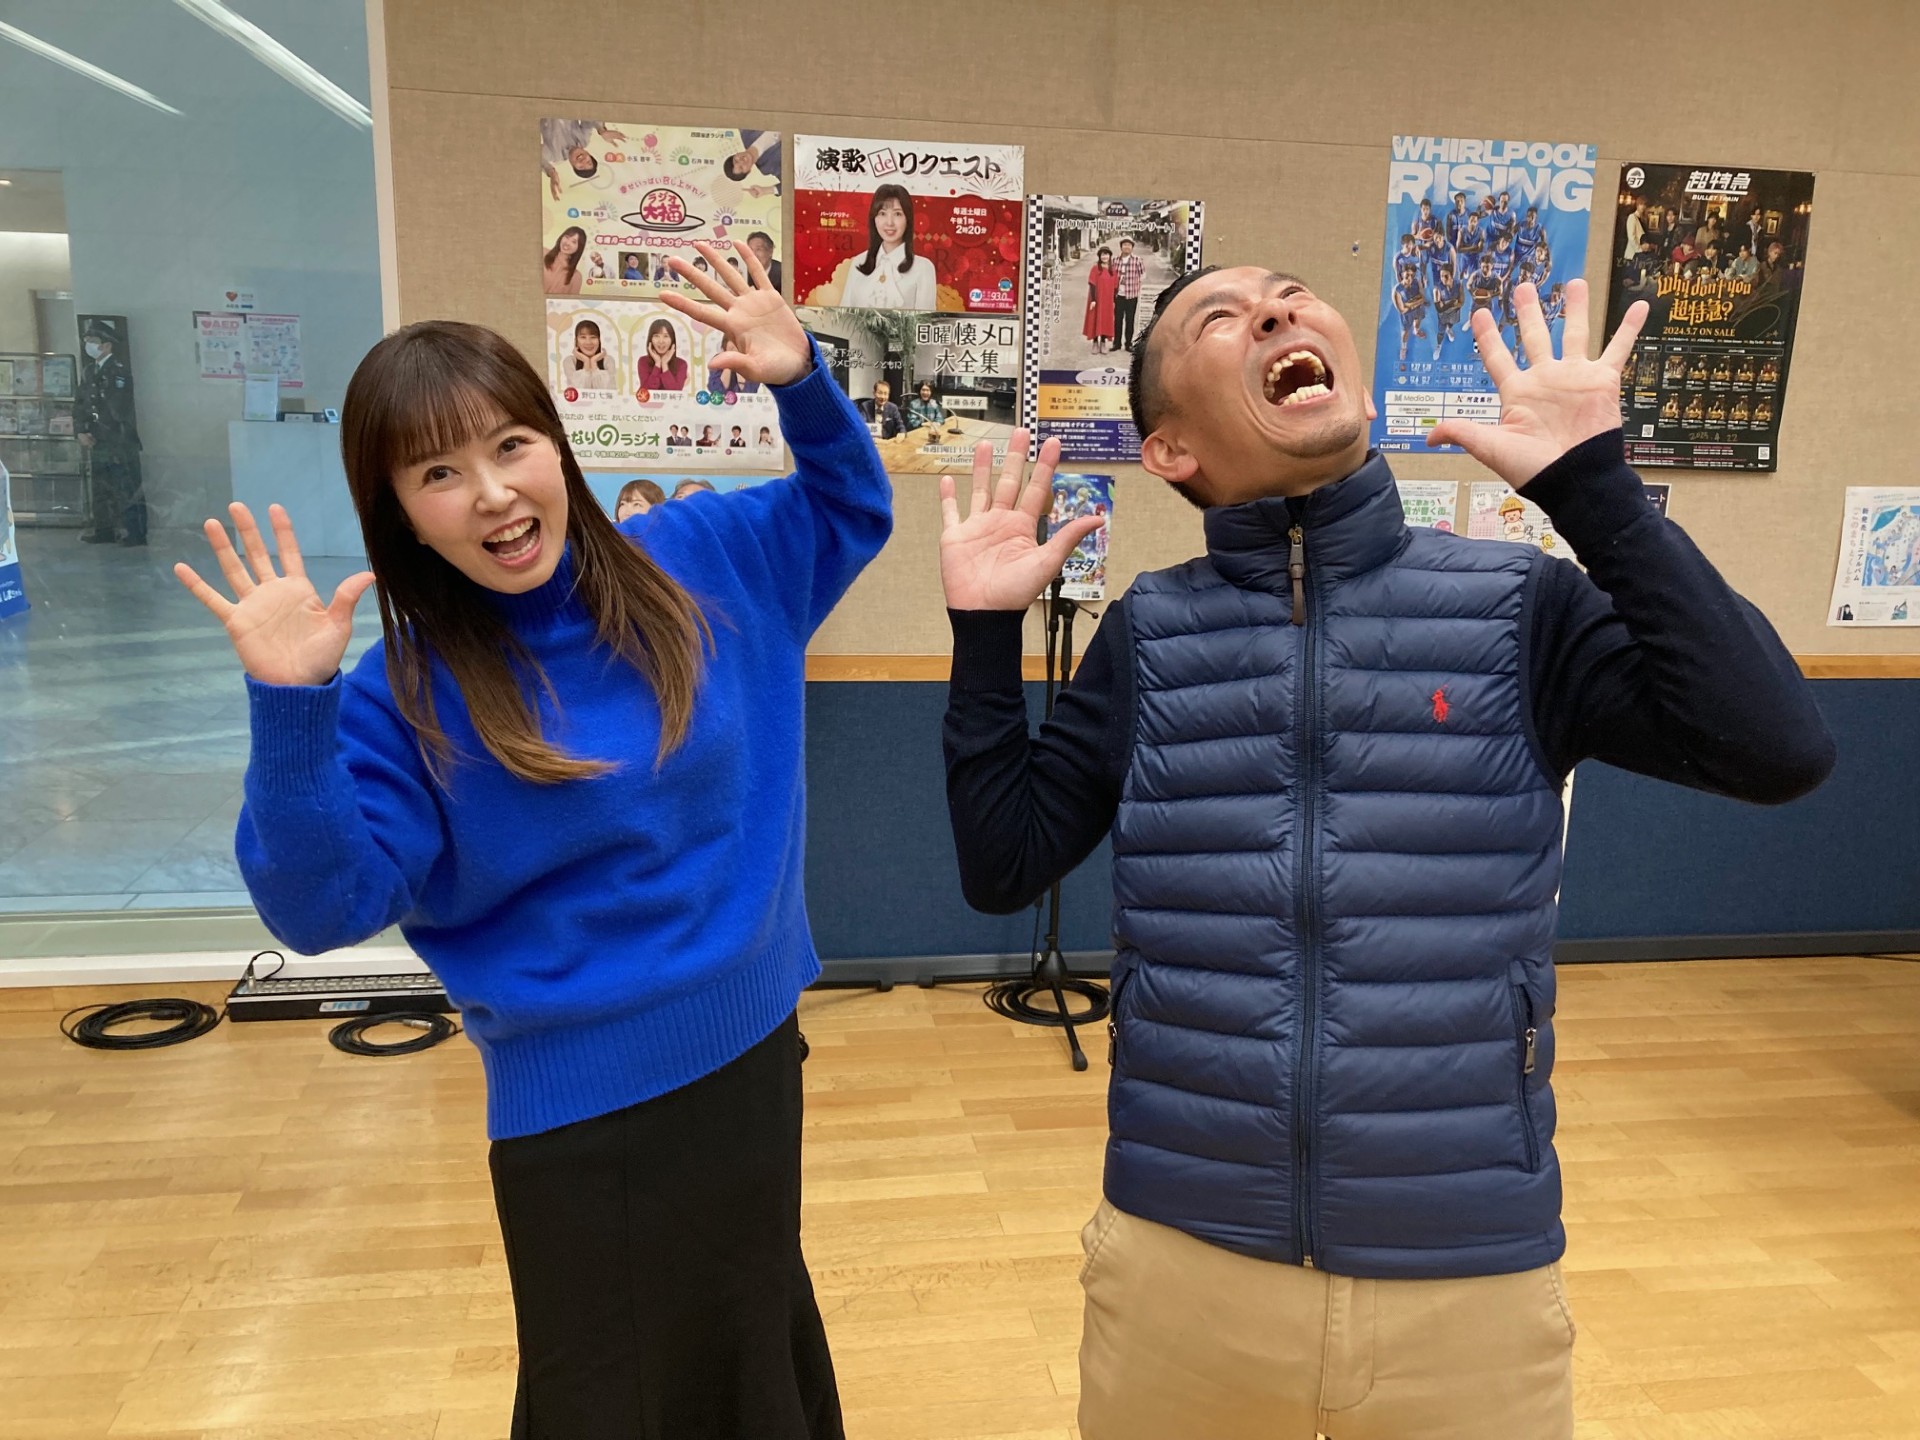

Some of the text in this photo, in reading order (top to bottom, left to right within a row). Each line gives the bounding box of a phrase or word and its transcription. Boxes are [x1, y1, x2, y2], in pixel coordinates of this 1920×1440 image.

[1391, 135, 1597, 169] WHIRLPOOL
[1387, 160, 1594, 213] RISING
[1685, 170, 1751, 195] 超特急
[647, 191, 678, 206] ラジオ
[643, 202, 684, 223] 大福
[1656, 275, 1690, 298] Why
[1699, 327, 1713, 336] ON
[1714, 328, 1736, 337] SALE
[934, 349, 1000, 375] 大全集
[565, 424, 660, 447] なりのラジオ
